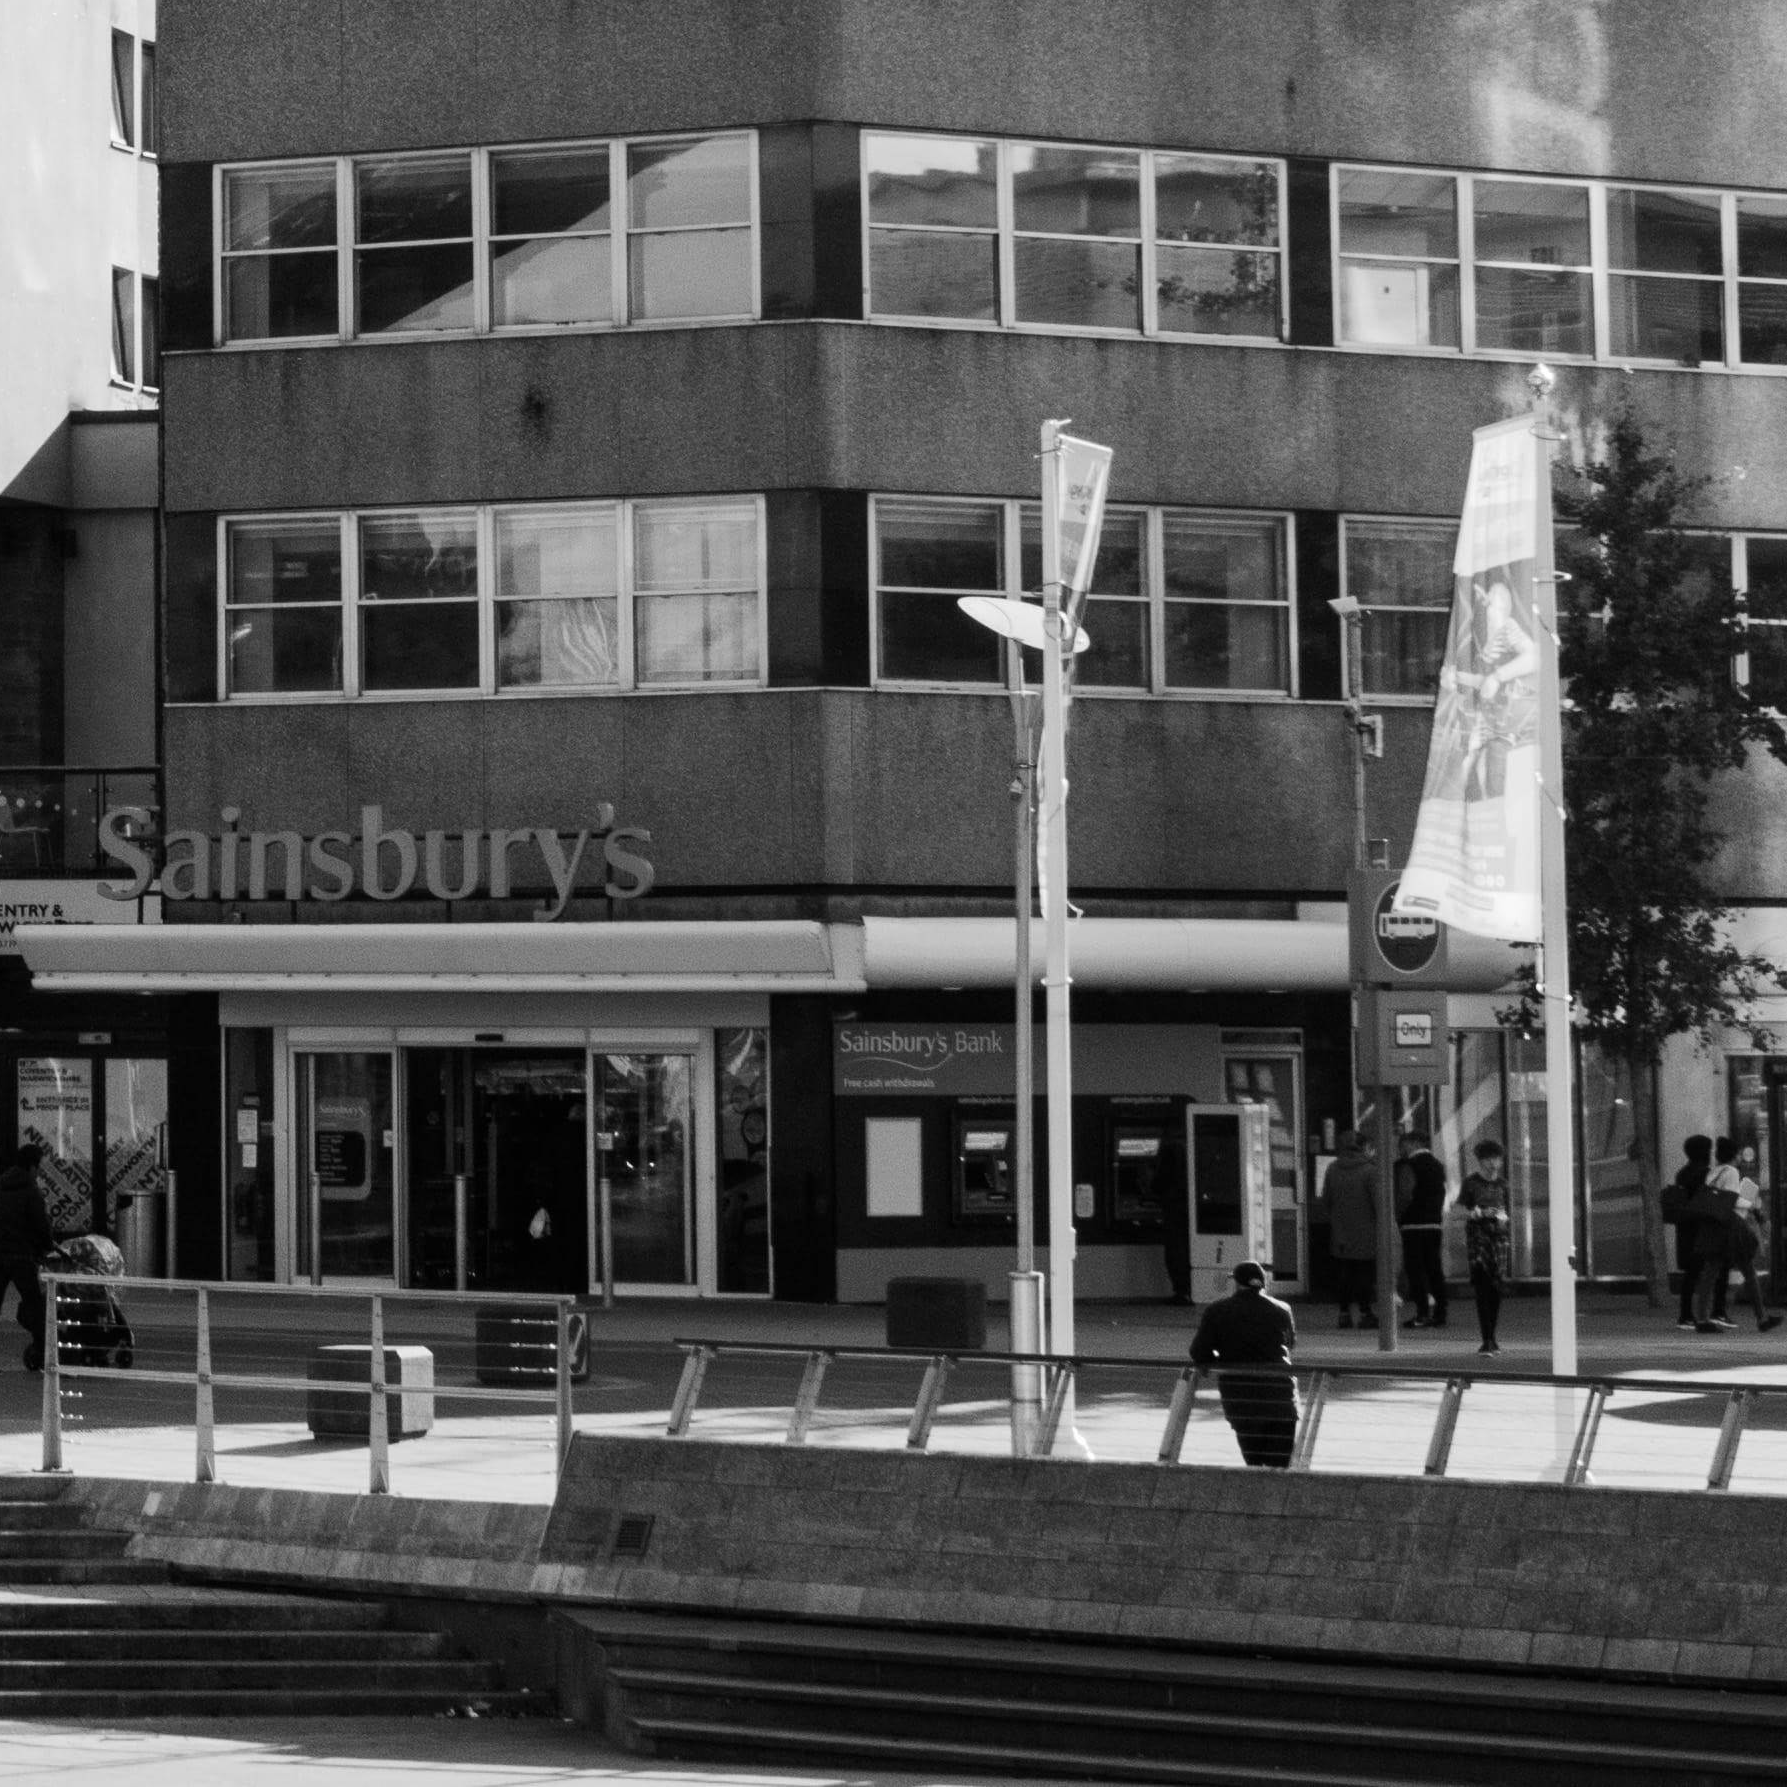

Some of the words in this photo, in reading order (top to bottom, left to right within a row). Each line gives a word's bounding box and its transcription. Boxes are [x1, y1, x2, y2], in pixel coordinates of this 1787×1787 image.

[97, 803, 654, 922] Sainsbury's
[52, 904, 63, 918] &
[1401, 1021, 1427, 1039] Only
[840, 1030, 948, 1058] Sainsbury's
[954, 1030, 1003, 1054] Bank
[843, 1078, 863, 1088] Free
[863, 1078, 883, 1088] cash
[884, 1078, 935, 1088] withdrawals
